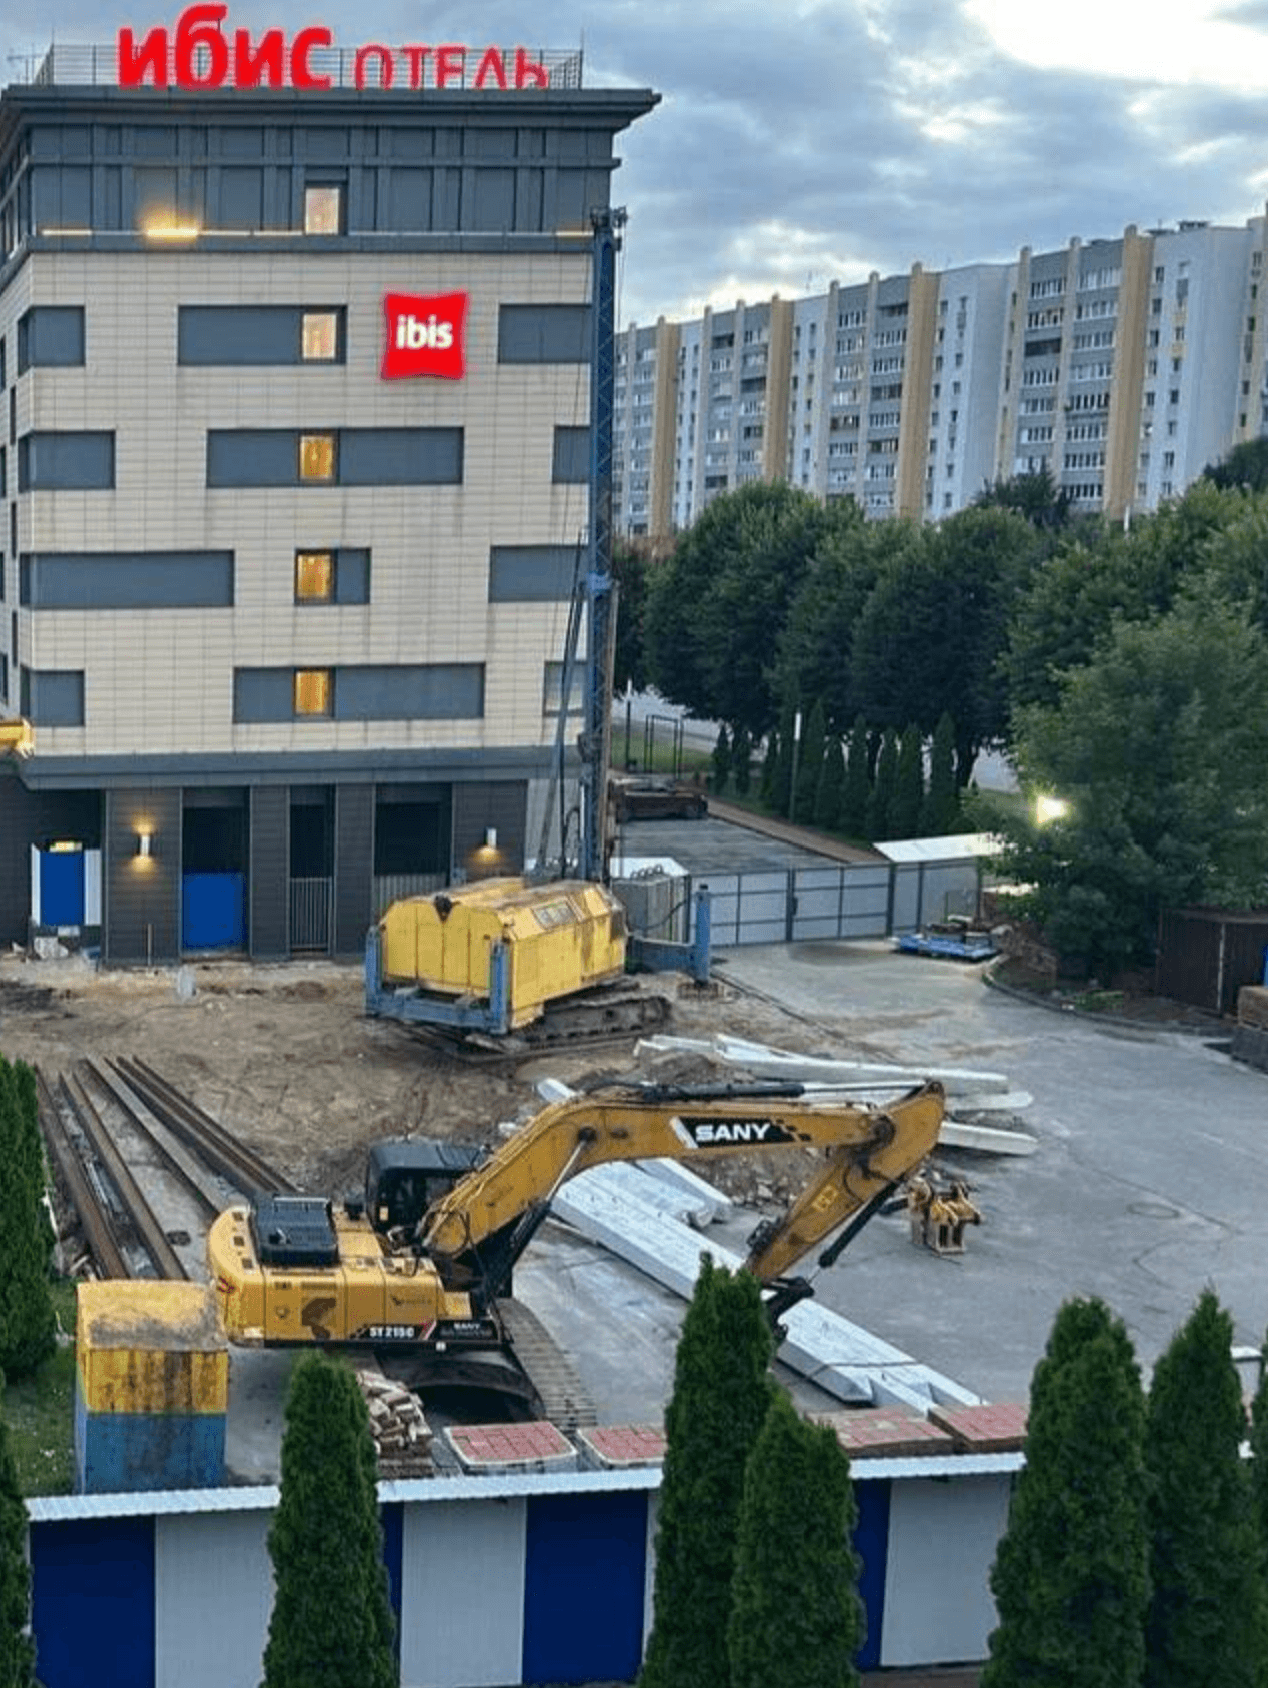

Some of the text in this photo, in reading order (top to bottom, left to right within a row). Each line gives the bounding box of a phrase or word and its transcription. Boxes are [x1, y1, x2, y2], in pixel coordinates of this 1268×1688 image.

[118, 4, 331, 90] ибис
[396, 314, 453, 350] ibis
[695, 1123, 770, 1141] SANY
